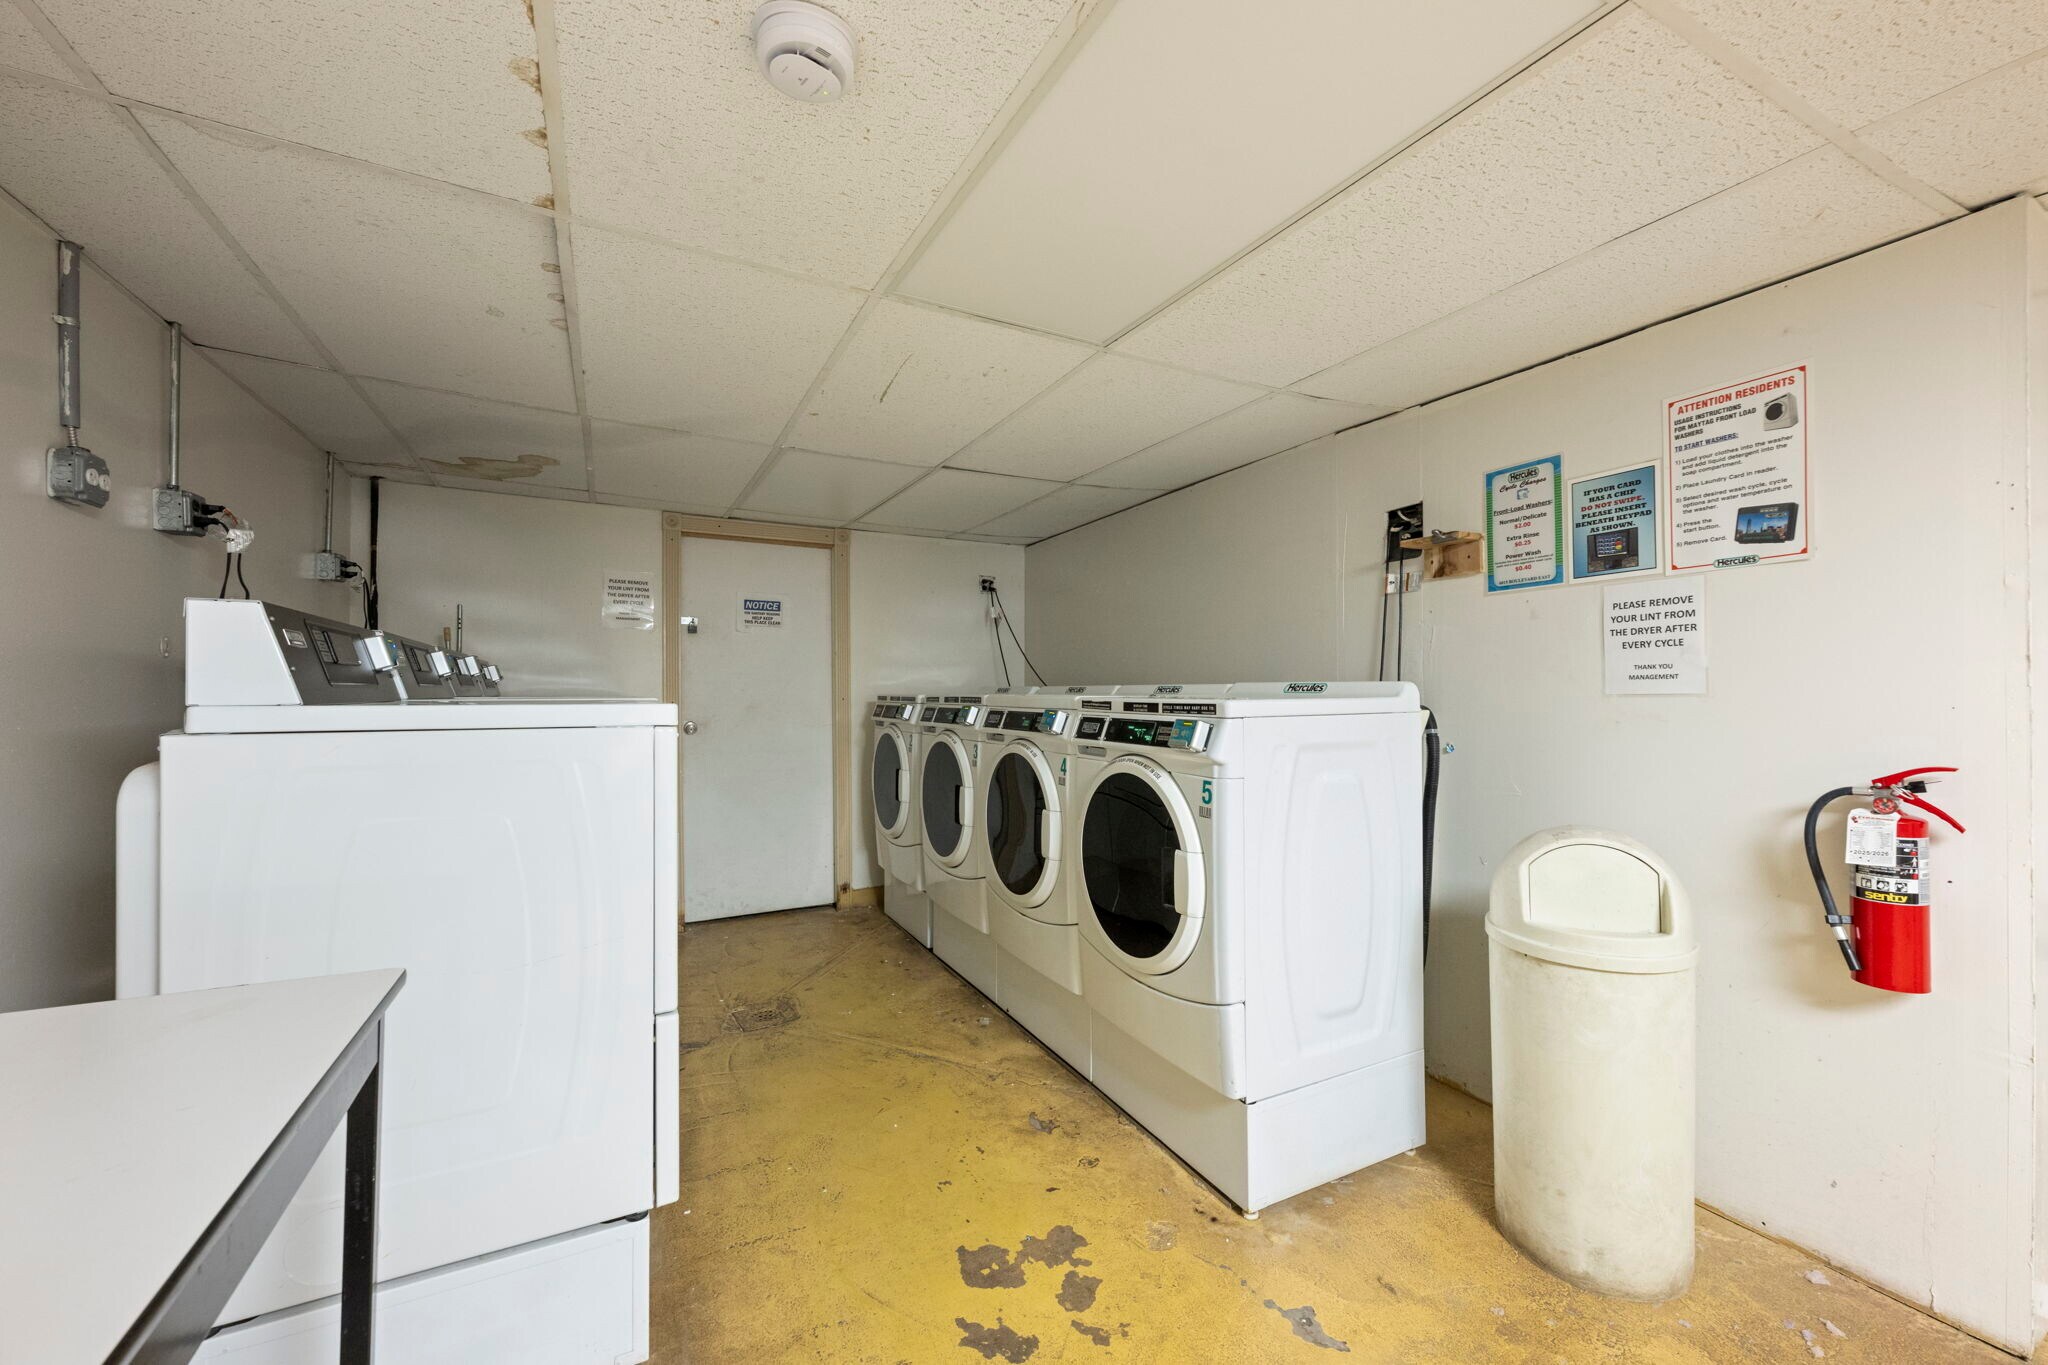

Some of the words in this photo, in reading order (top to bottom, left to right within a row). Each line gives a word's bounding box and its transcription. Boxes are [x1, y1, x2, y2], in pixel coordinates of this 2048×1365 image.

[1678, 393, 1732, 415] ATTENTION
[1736, 376, 1795, 399] RESIDENTS
[1674, 416, 1694, 426] USAGE
[1695, 404, 1742, 420] INSTRUCTIONS
[1688, 418, 1714, 430] MAYTAG
[1716, 412, 1737, 422] FRONT
[1739, 408, 1756, 416] LOAD
[1674, 429, 1704, 440] WASHERS
[1684, 442, 1704, 450] START
[1706, 433, 1739, 445] WASHERS:
[1682, 456, 1698, 464] Load
[1699, 452, 1712, 460] your
[1714, 447, 1738, 456] clothes
[1768, 434, 1793, 444] washer
[1728, 450, 1760, 460] detergent
[1698, 460, 1742, 473] compartment.
[1510, 468, 1538, 480] Hercules
[1683, 480, 1700, 488] Place
[1701, 476, 1726, 486] Laundry
[1754, 466, 1778, 475] reader.
[1500, 483, 1517, 493] Cycle
[1519, 477, 1547, 488] Charges
[1590, 485, 1615, 495] YOUR
[1617, 480, 1642, 489] CARD
[1703, 488, 1727, 498] desired
[1728, 484, 1746, 492] wash
[1769, 478, 1788, 486] cycle
[1589, 494, 1605, 502] HAS
[1614, 488, 1636, 498] CHIP
[1683, 500, 1706, 509] options
[1721, 494, 1739, 502] water
[1740, 486, 1781, 499] temperature
[1493, 504, 1525, 516] Front-Load
[1526, 500, 1553, 510] Washers:
[1594, 502, 1612, 510] NOT
[1614, 496, 1645, 506] SWIPE.
[1694, 504, 1718, 512] washer.
[1582, 509, 1612, 519] PLEASE
[1614, 502, 1647, 513] INSERT
[1499, 512, 1547, 526] Normal/Delicate
[1576, 517, 1614, 528] BENEATH
[1616, 510, 1652, 520] KEYPAD
[1684, 520, 1700, 528] Press
[1602, 521, 1636, 532] SHOWN.
[1698, 524, 1720, 532] button.
[1523, 532, 1540, 540] Rinse
[1684, 538, 1708, 546] Remove
[1717, 556, 1756, 566] Hercules
[746, 600, 780, 610] NOTICE
[1612, 600, 1646, 610] PLEASE
[1649, 595, 1694, 606] REMOVE
[1611, 614, 1637, 623] YOUR
[1640, 612, 1661, 621] LINT
[1664, 610, 1696, 619] FROM
[1610, 628, 1628, 636] THE
[1630, 626, 1662, 636] DRYER
[1665, 624, 1697, 634] AFTER
[1622, 641, 1652, 650] EVERY
[1655, 638, 1684, 648] CYCLE
[1157, 686, 1180, 694] Hercules
[1288, 683, 1324, 692] Hercules
[974, 744, 978, 759] 3
[1060, 758, 1067, 776] 4
[1202, 780, 1212, 804] 5
[1864, 891, 1908, 903] sentry
